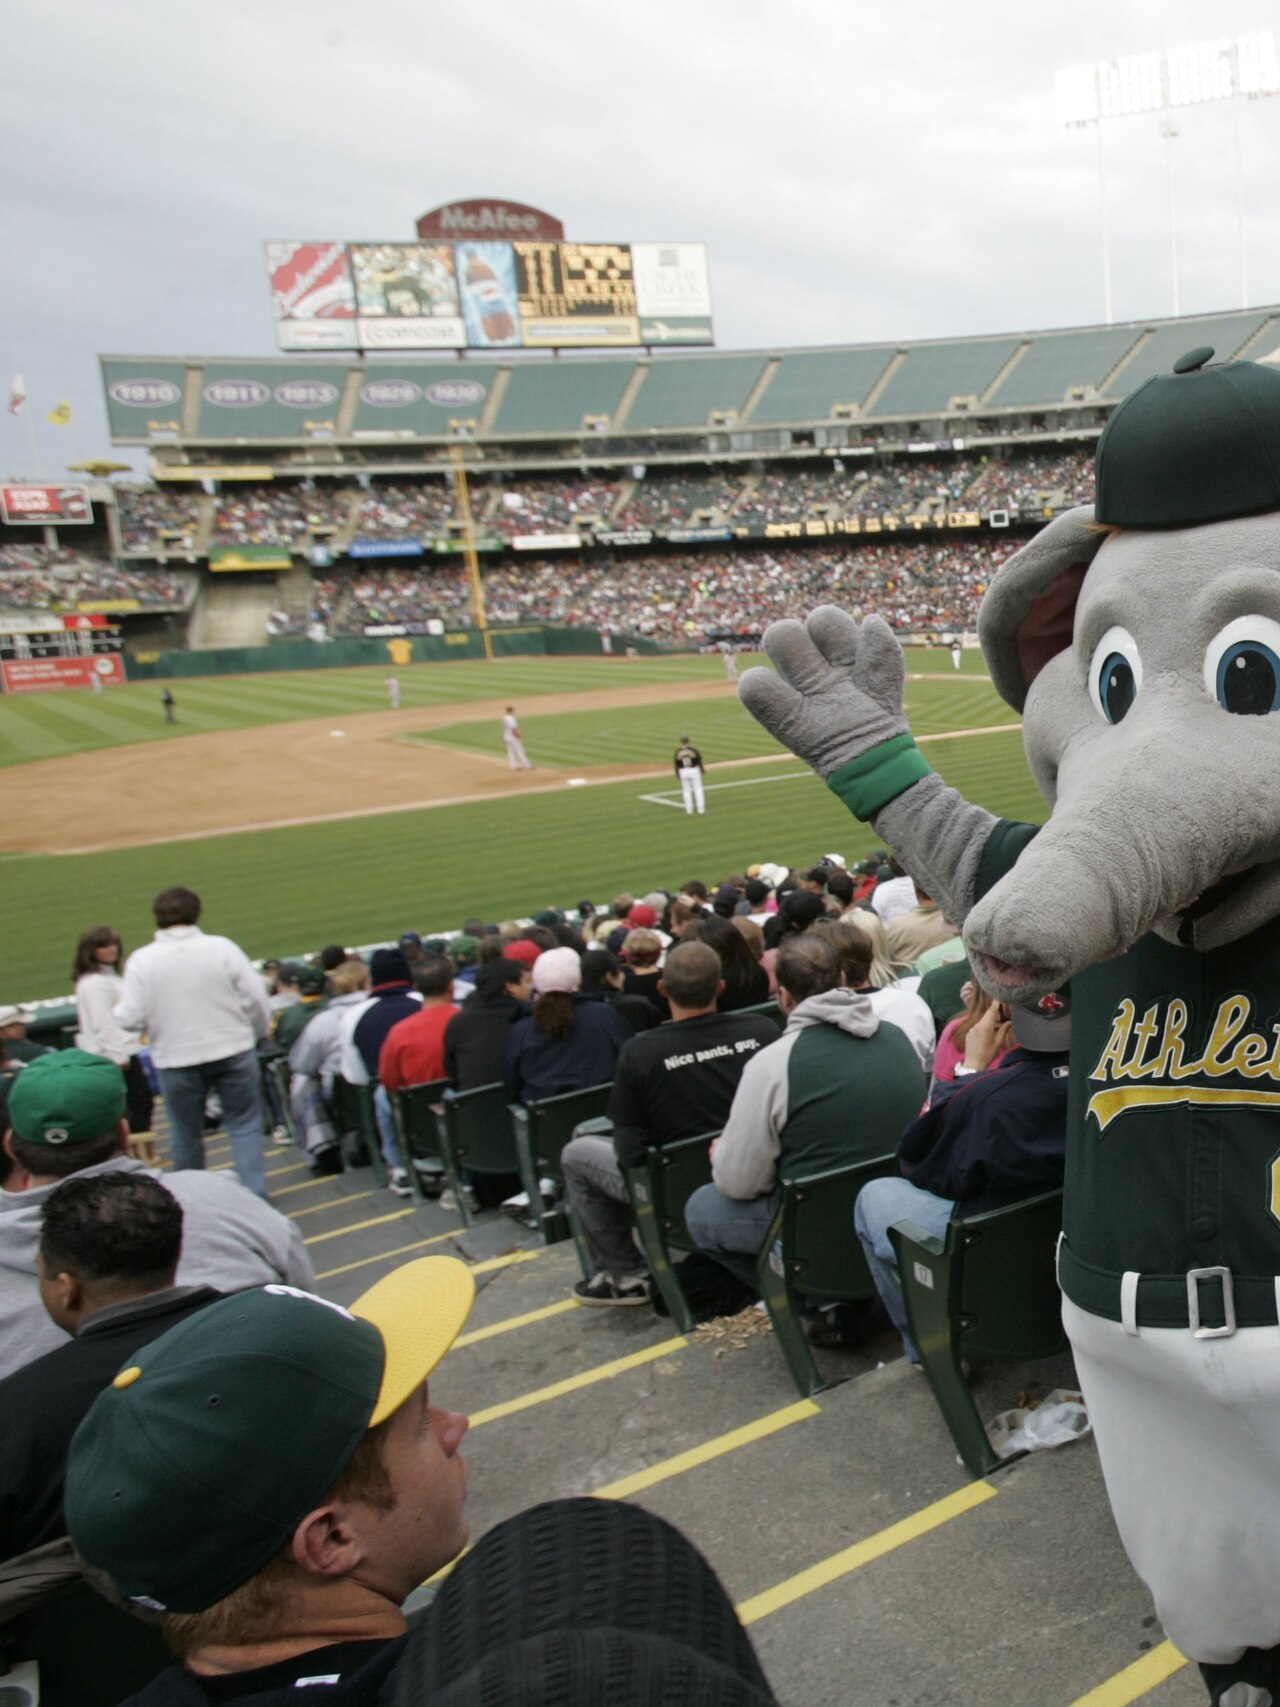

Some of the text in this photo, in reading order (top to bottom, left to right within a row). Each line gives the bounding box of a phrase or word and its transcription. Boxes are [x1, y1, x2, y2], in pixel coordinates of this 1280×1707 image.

[440, 204, 538, 231] McAfee
[119, 385, 173, 401] 1910
[210, 385, 262, 401] 1911
[663, 1038, 761, 1071] Nice pants, guy.
